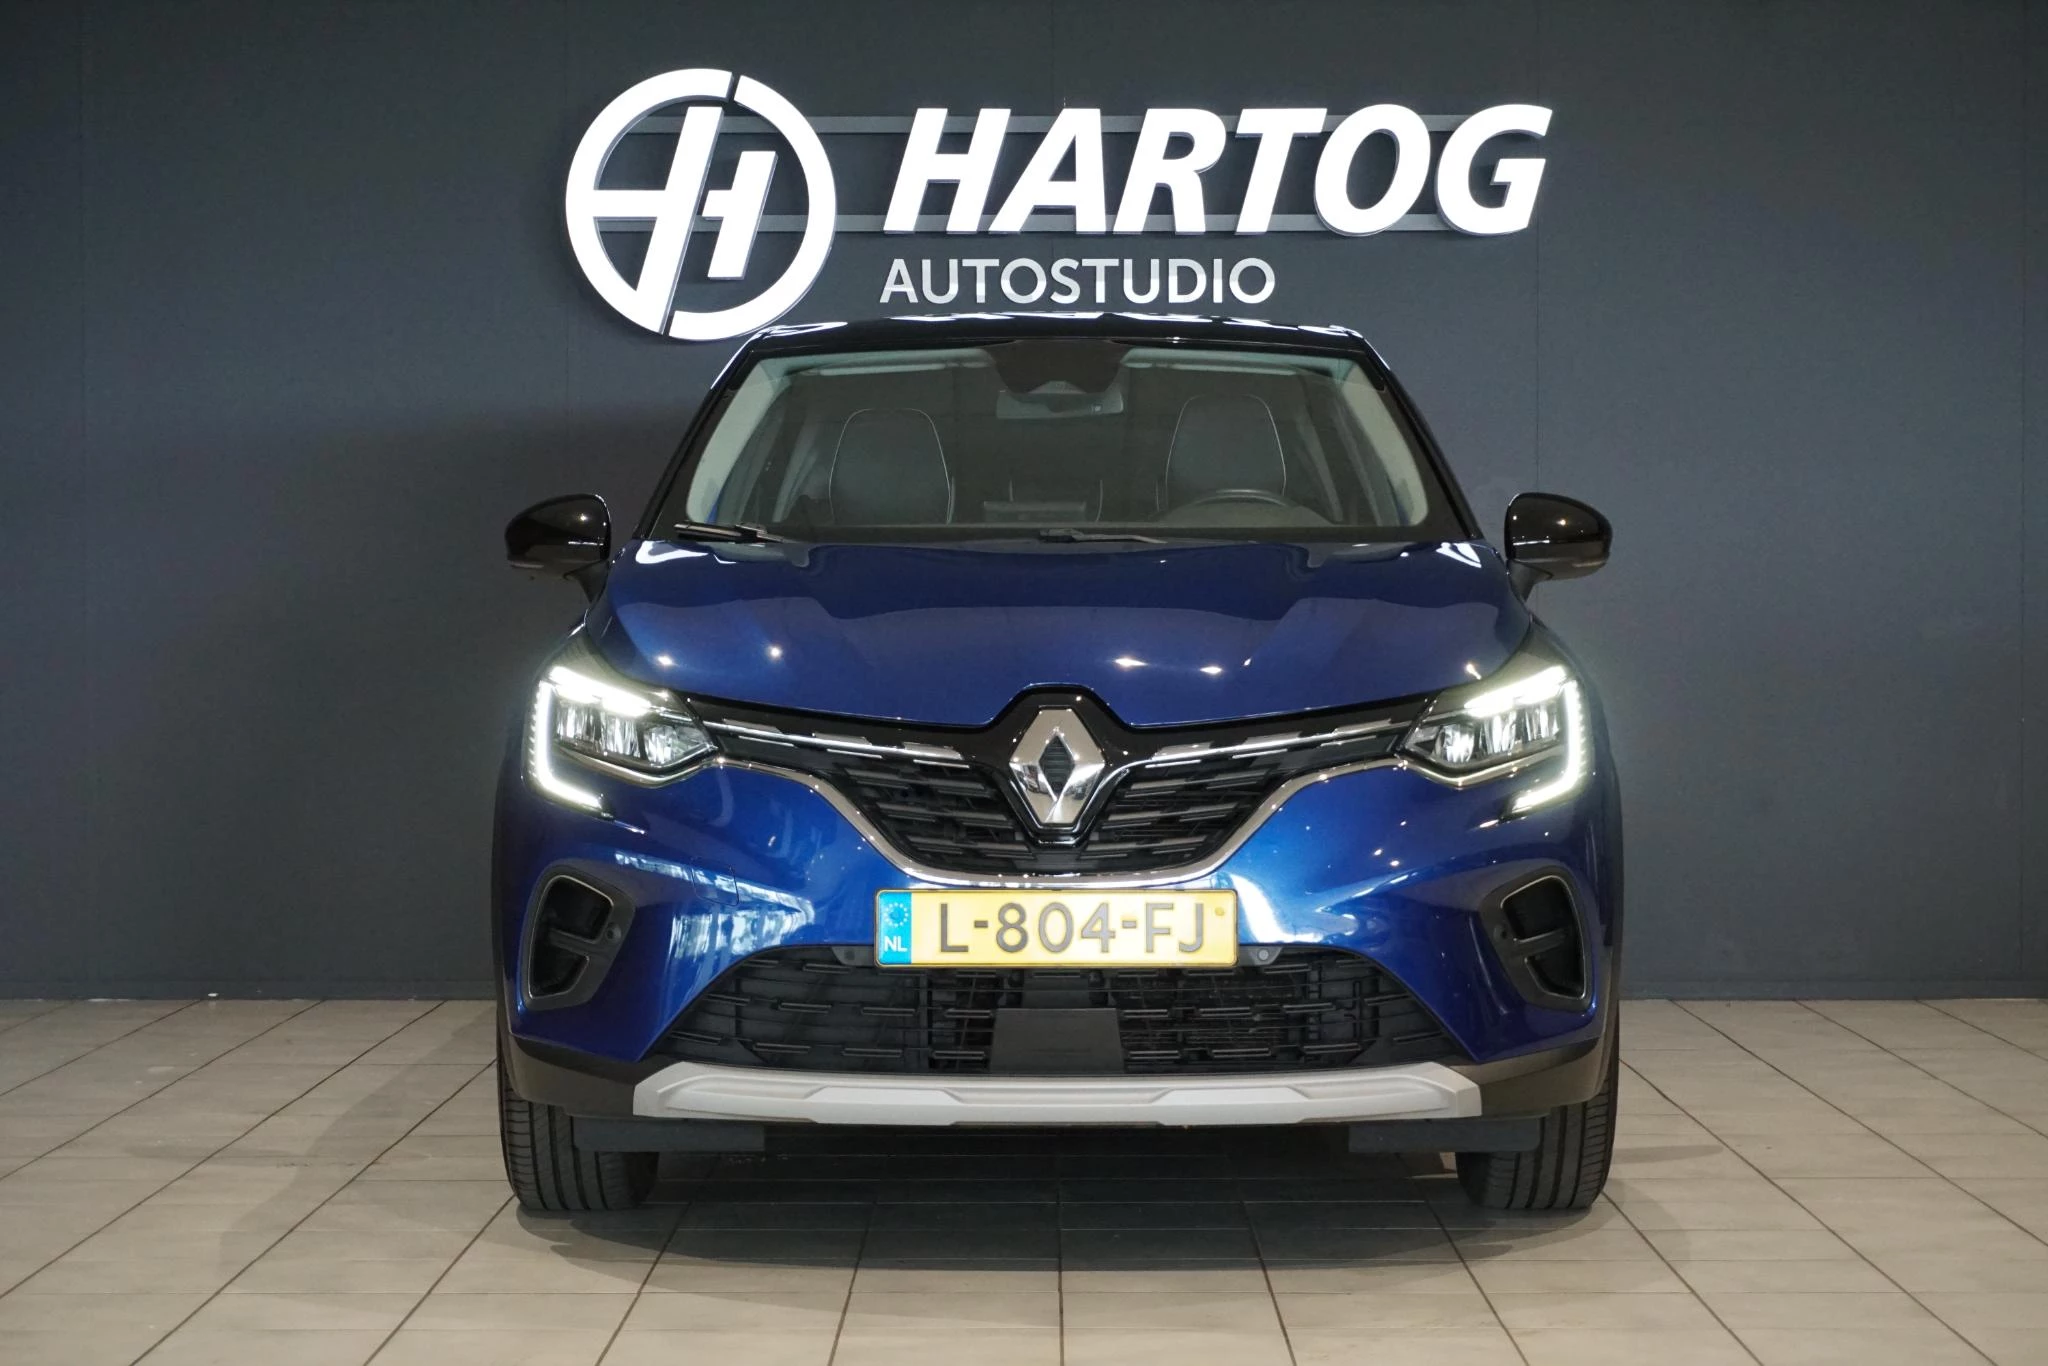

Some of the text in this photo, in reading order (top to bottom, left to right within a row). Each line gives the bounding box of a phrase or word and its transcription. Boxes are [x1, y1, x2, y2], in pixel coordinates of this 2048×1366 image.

[883, 104, 1554, 237] HARTOG
[880, 256, 1276, 305] AUTOSTUDIO
[884, 936, 908, 953] NL
[939, 901, 1205, 953] L-804-FJ
